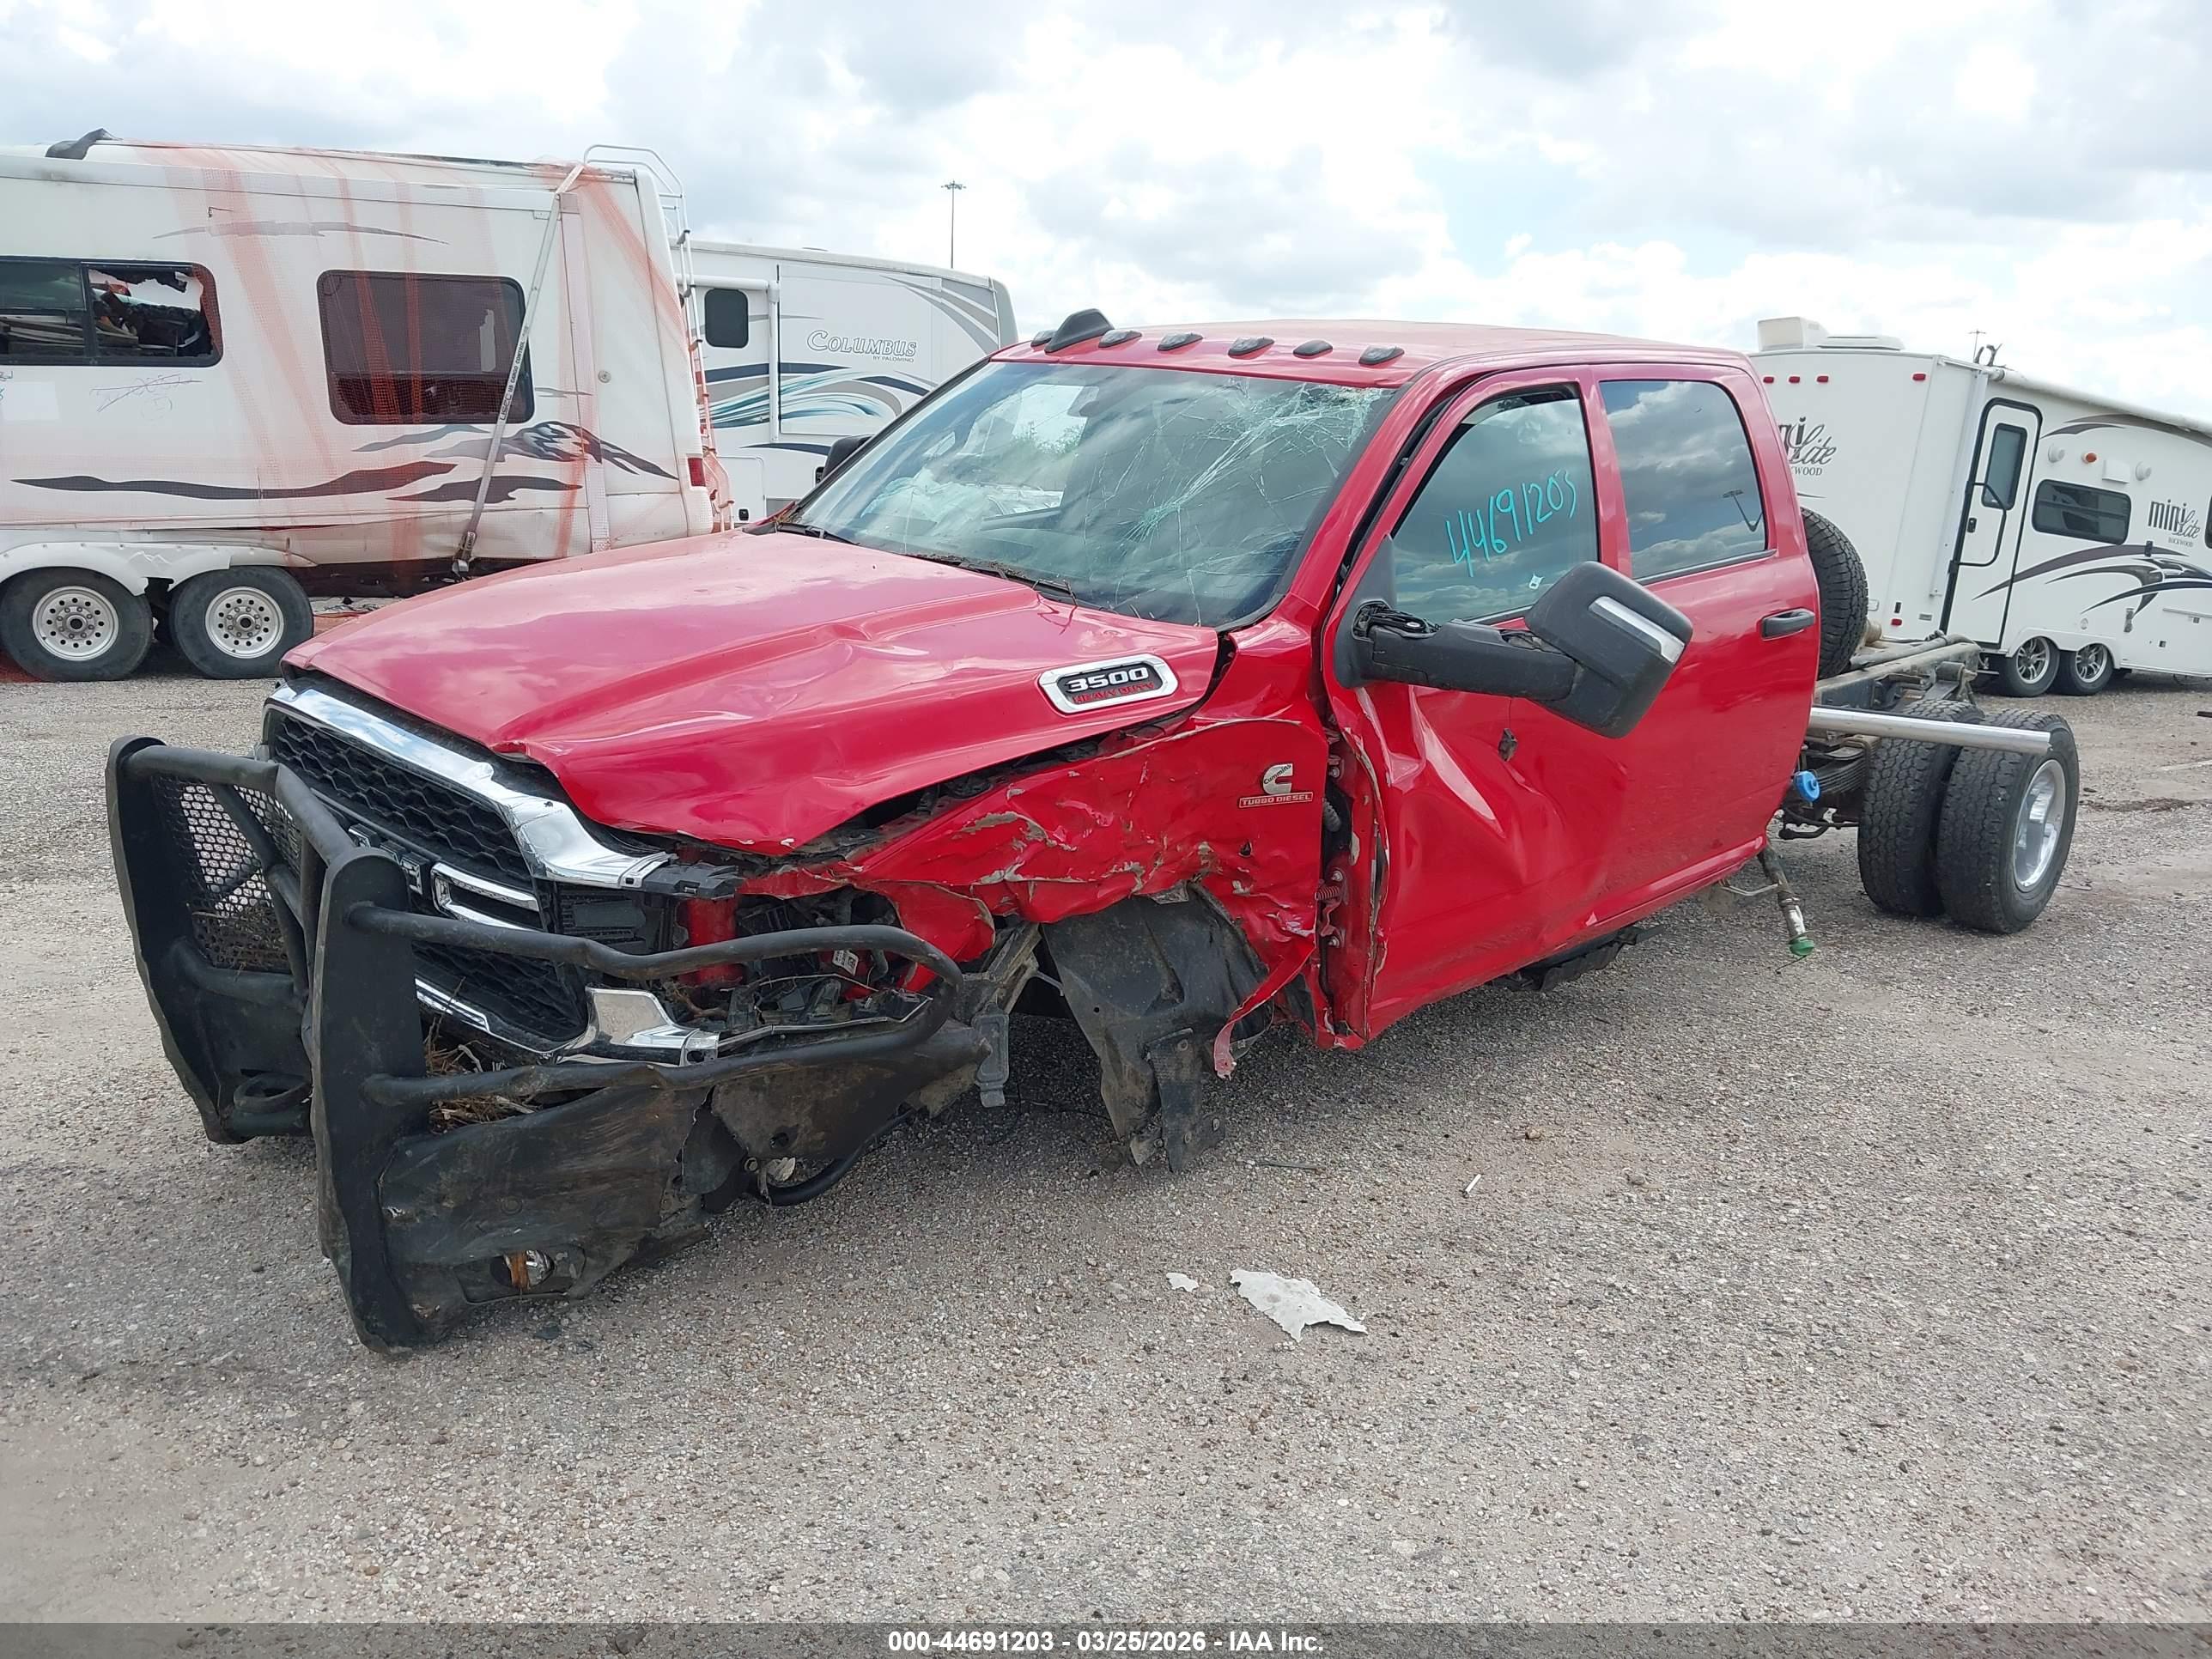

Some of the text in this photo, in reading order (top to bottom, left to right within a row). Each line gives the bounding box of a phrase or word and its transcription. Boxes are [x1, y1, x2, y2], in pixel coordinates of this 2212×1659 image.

[807, 330, 916, 356] COLUMBUS
[1446, 468, 1577, 578] 44691203
[2148, 499, 2186, 532] mini
[1066, 667, 1149, 692] 3500
[1073, 682, 1155, 703] HEAVY DUTY
[1264, 764, 1291, 785] Cummins
[1243, 794, 1311, 806] TURBO DIESEL
